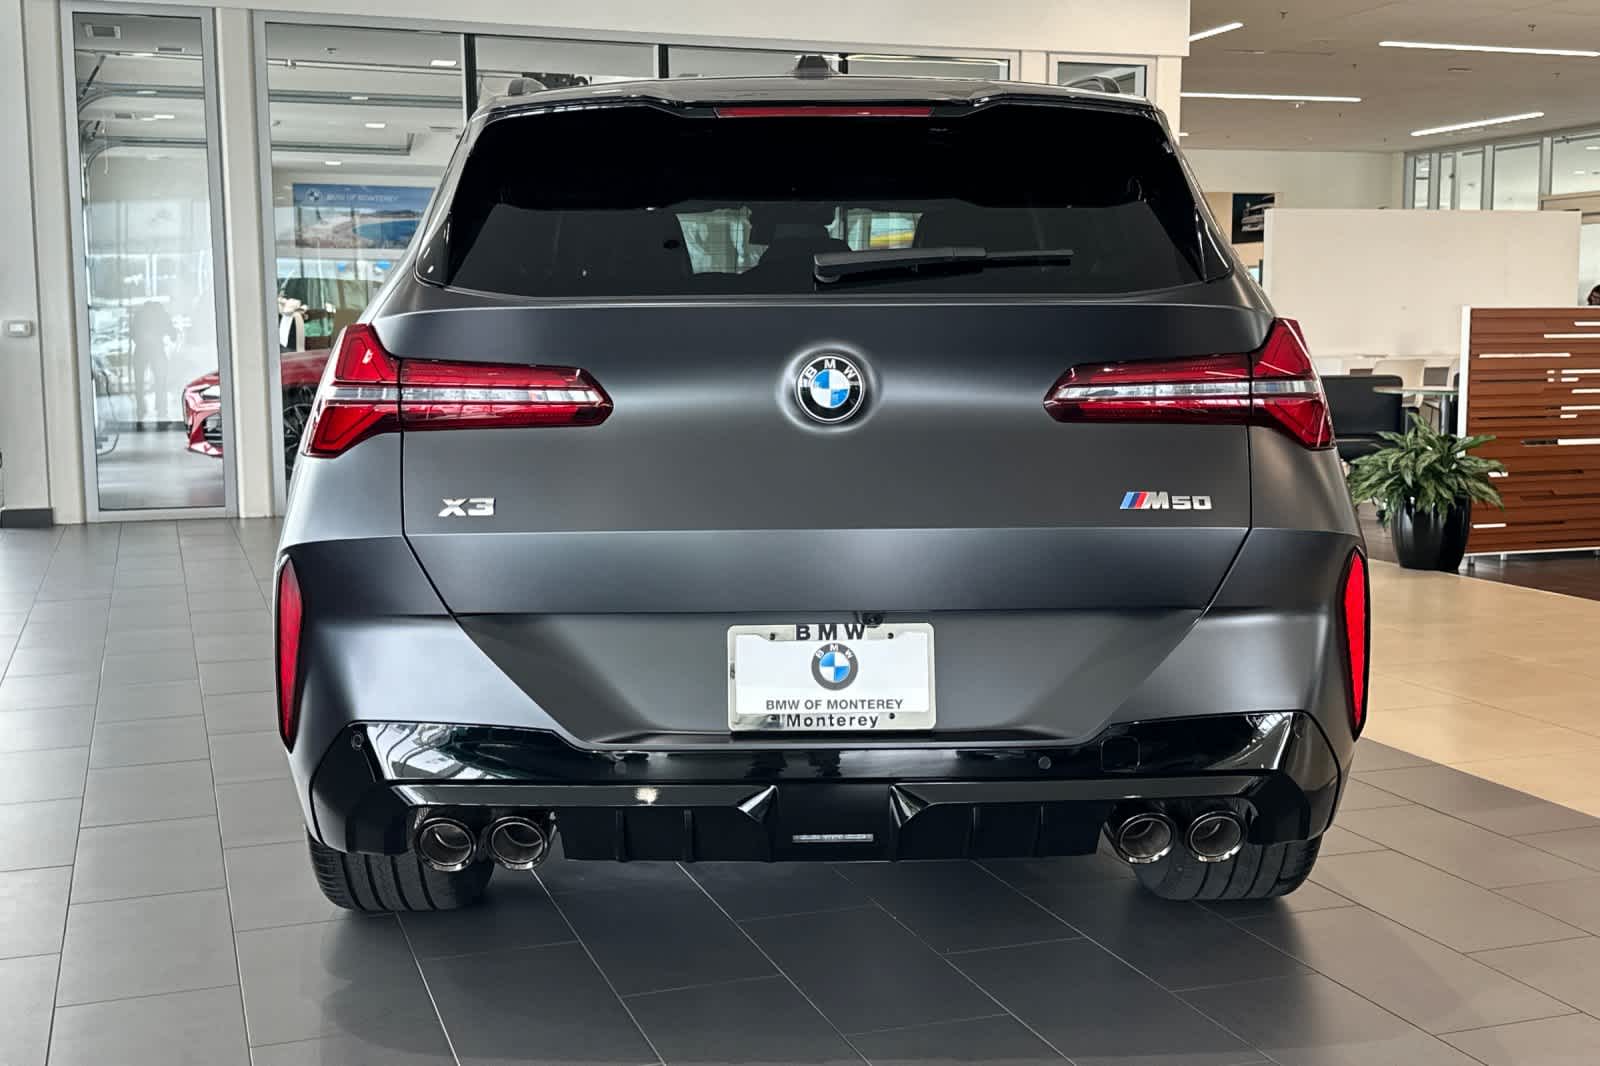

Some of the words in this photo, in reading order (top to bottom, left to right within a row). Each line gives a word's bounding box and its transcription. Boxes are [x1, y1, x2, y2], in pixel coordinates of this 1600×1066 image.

[803, 358, 857, 380] BMW
[438, 498, 495, 517] X3
[1143, 491, 1213, 510] M50
[796, 624, 865, 640] BMW
[815, 643, 854, 659] BMW
[766, 699, 800, 711] BMW
[804, 699, 822, 710] OF
[826, 698, 904, 710] MONTEREY
[786, 713, 879, 728] Monterey
